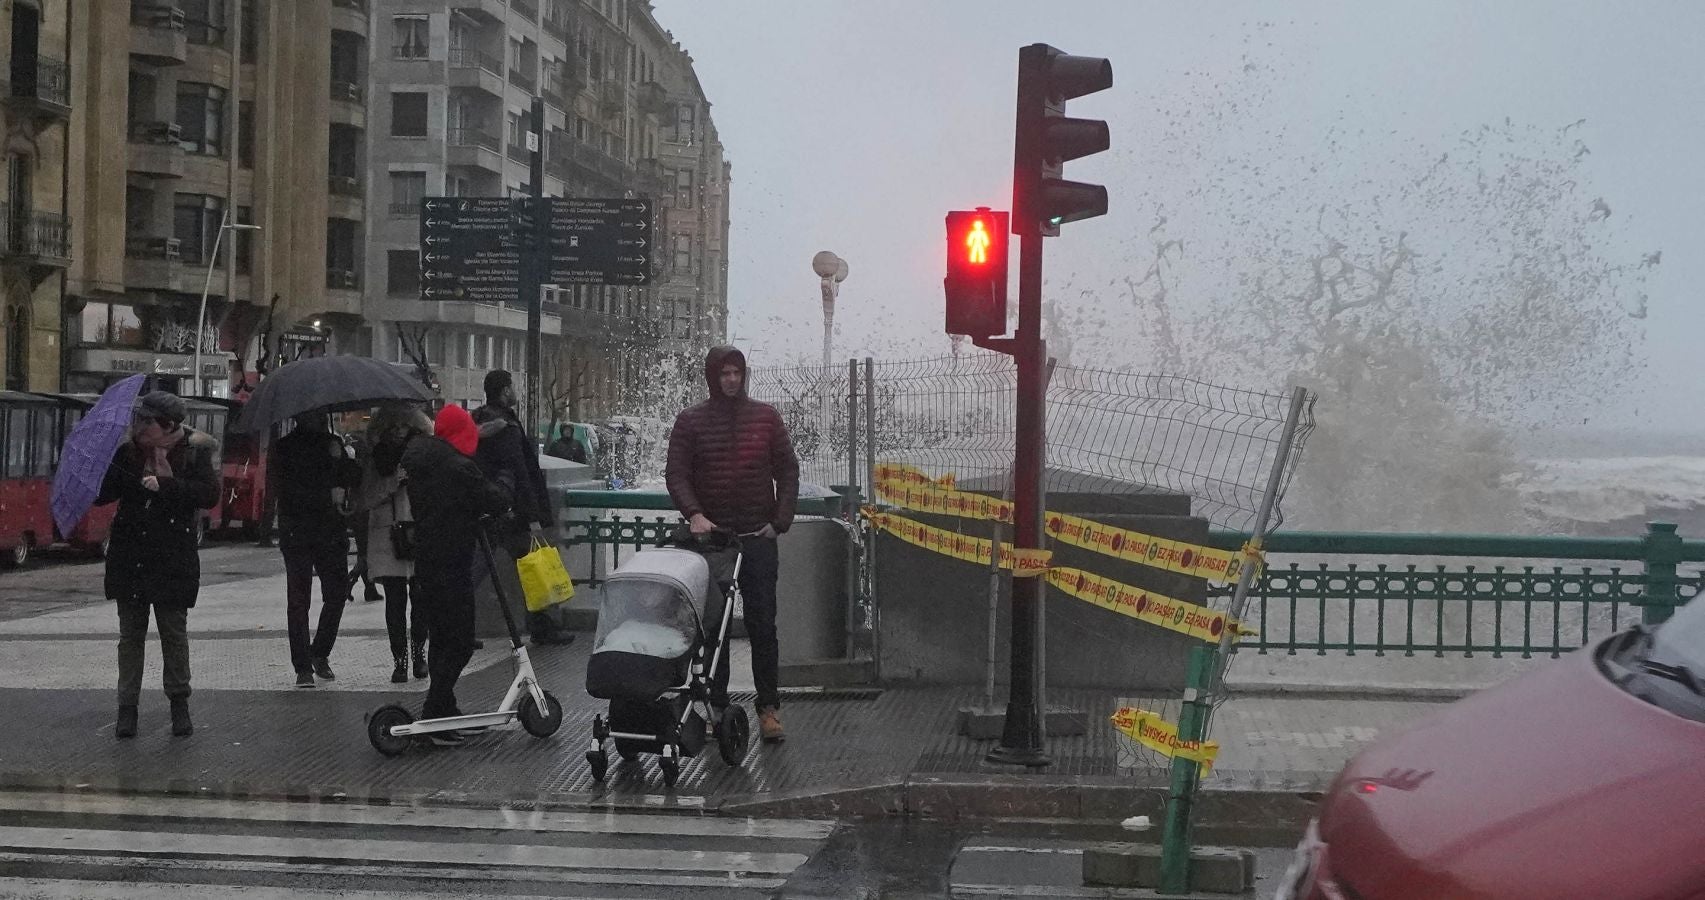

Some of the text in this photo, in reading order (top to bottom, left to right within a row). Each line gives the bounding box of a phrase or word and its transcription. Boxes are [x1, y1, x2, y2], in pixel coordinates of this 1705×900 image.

[1156, 547, 1166, 560] EZ
[1203, 556, 1228, 573] PASAR
[1153, 602, 1176, 619] PASAR
[1184, 611, 1195, 625] EZ
[1195, 614, 1210, 630] PASA
